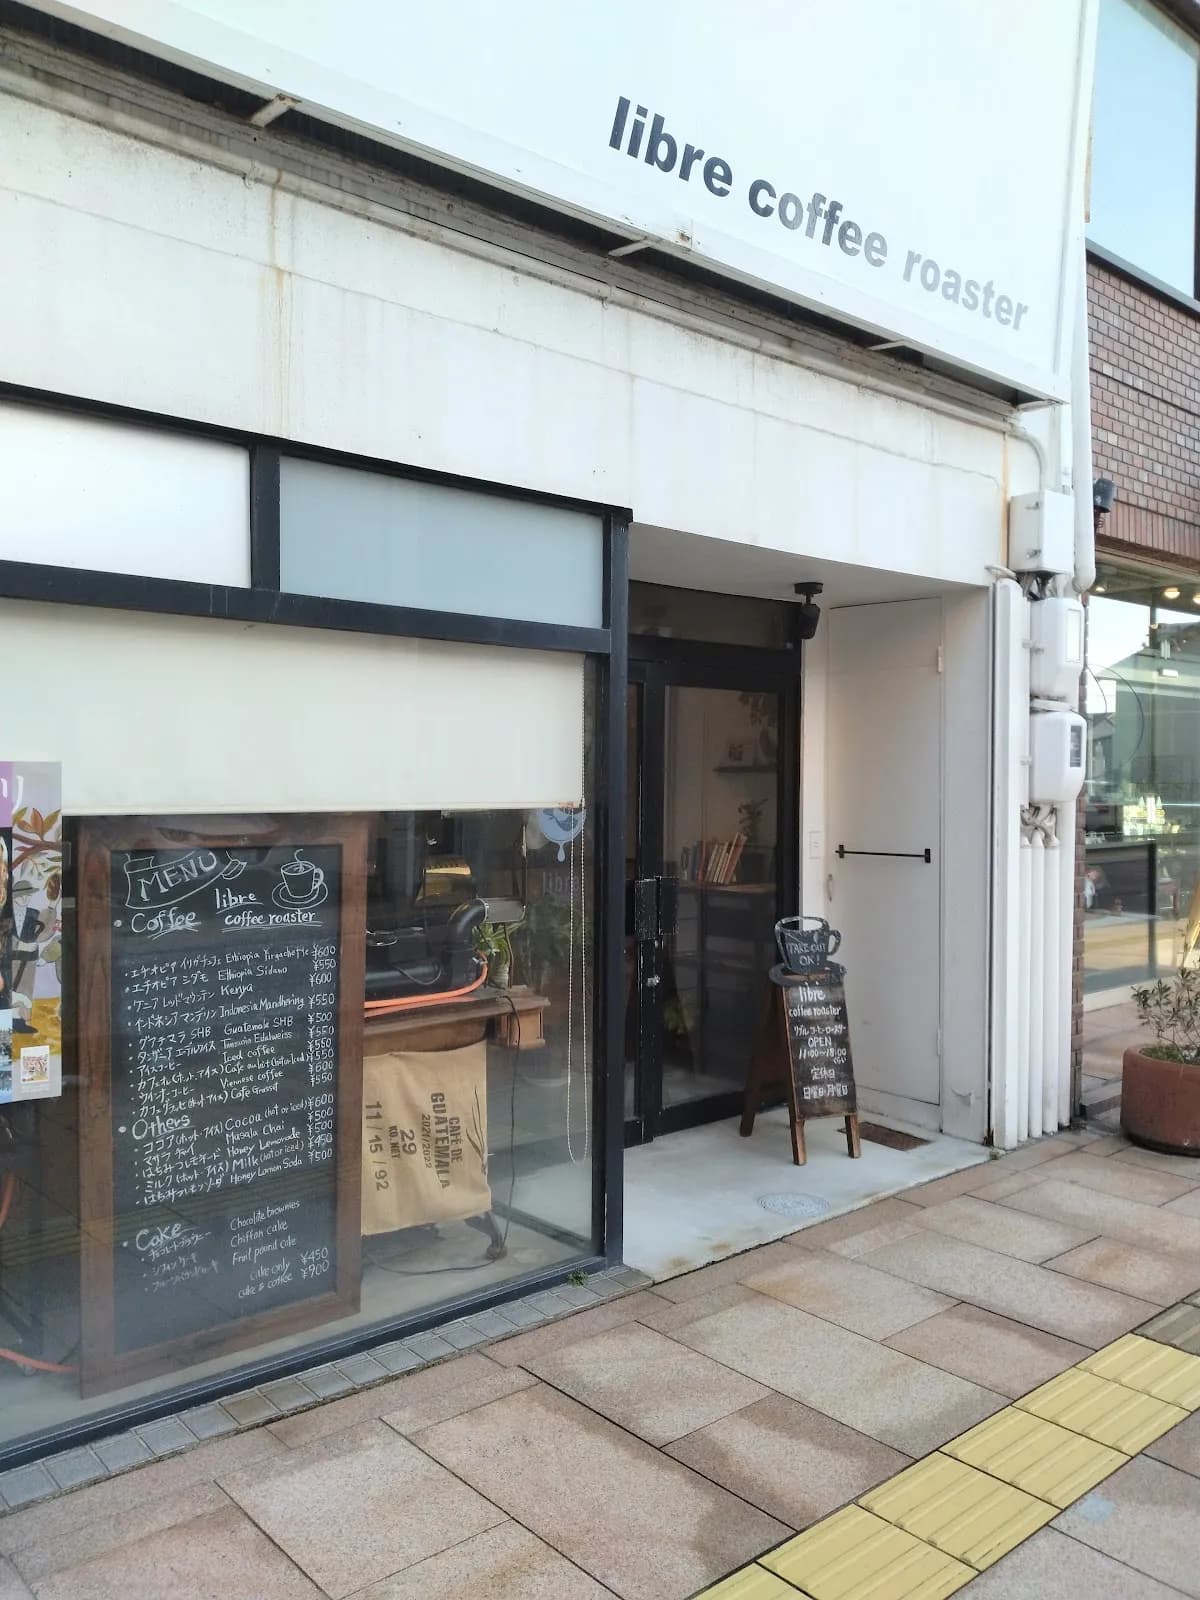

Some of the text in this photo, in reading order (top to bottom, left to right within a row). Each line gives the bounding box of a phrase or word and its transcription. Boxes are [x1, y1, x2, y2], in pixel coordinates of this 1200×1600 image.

[608, 95, 1029, 331] libre coffee roaster
[137, 851, 217, 902] MENU
[215, 887, 257, 909] libre
[131, 906, 200, 933] Coffee
[224, 908, 316, 927] coffee roaster
[225, 951, 260, 966] Ethiopia
[786, 943, 826, 954] TAKE OUT
[131, 976, 178, 995] エチオピア
[218, 968, 253, 982] Ethiopia
[312, 958, 337, 971] ¥550
[220, 984, 253, 1000] Kenya
[309, 972, 332, 987] ¥600
[218, 1001, 260, 1018] Indonesia
[308, 993, 335, 1009] ¥550
[799, 984, 826, 1003] libre
[788, 1003, 842, 1017] coffee roaster
[190, 1026, 211, 1040] SHB
[273, 1016, 294, 1028] SHB
[307, 1012, 333, 1025] ¥500
[247, 1045, 276, 1058] coffee
[807, 1036, 832, 1048] OPEN
[257, 1068, 284, 1081] coffee
[308, 1060, 334, 1074] ¥600
[310, 1073, 333, 1087] ¥550
[811, 1065, 835, 1081] 定休日
[224, 1114, 263, 1131] Cocoa
[308, 1093, 334, 1110] ¥600
[131, 1114, 191, 1140] Others
[225, 1127, 259, 1145] Masala
[262, 1120, 285, 1135] Chai
[307, 1107, 334, 1122] ¥500
[227, 1144, 256, 1158] Honey
[259, 1127, 301, 1151] Lemonade
[307, 1120, 333, 1136] ¥500
[232, 1156, 259, 1172] Milk
[308, 1133, 333, 1149] ¥450
[400, 1128, 417, 1155] 29
[421, 1113, 433, 1169] 2021/2022
[431, 1092, 451, 1189] GUATEMALA
[230, 1171, 257, 1184] Honey
[282, 1154, 303, 1169] Soda
[307, 1148, 333, 1164] ¥500
[451, 1148, 463, 1164] DE
[135, 1223, 186, 1251] Cake
[230, 1229, 264, 1248] Chiffon
[266, 1219, 289, 1235] cake
[254, 1240, 278, 1264] pound
[271, 1257, 290, 1278] only
[300, 1247, 329, 1265] ¥450
[300, 1260, 330, 1279] ¥900
